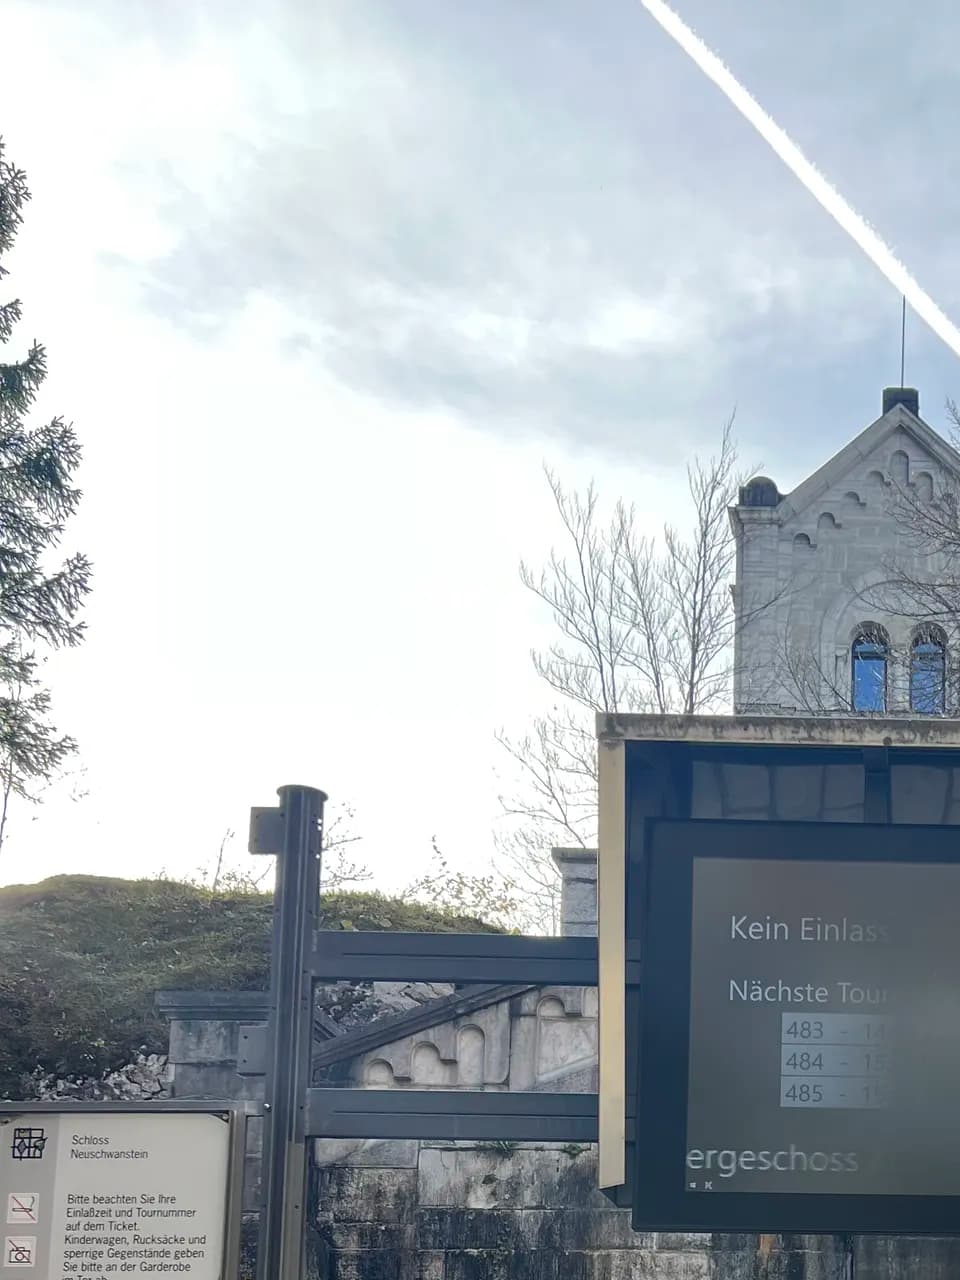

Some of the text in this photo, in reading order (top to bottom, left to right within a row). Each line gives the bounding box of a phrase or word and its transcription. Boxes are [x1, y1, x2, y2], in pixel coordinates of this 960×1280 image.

[731, 916, 789, 941] Kein
[729, 979, 829, 1003] Nächste
[786, 1021, 824, 1039] 483
[785, 1052, 824, 1070] 484
[785, 1084, 823, 1102] 485
[72, 1135, 109, 1145] Schloss
[71, 1149, 148, 1159] Neuschwanstein
[67, 1194, 176, 1204] Bitte beachten Sie Ihre
[115, 1208, 132, 1218] und
[136, 1208, 196, 1218] Tournummer
[66, 1221, 140, 1231] auf dem Ticket.
[65, 1235, 206, 1246] Kinderwagen, Rucksäcke und
[64, 1248, 204, 1260] sperrige Gegenstände geben
[63, 1262, 191, 1272] Sie bitte an der Garderobe
